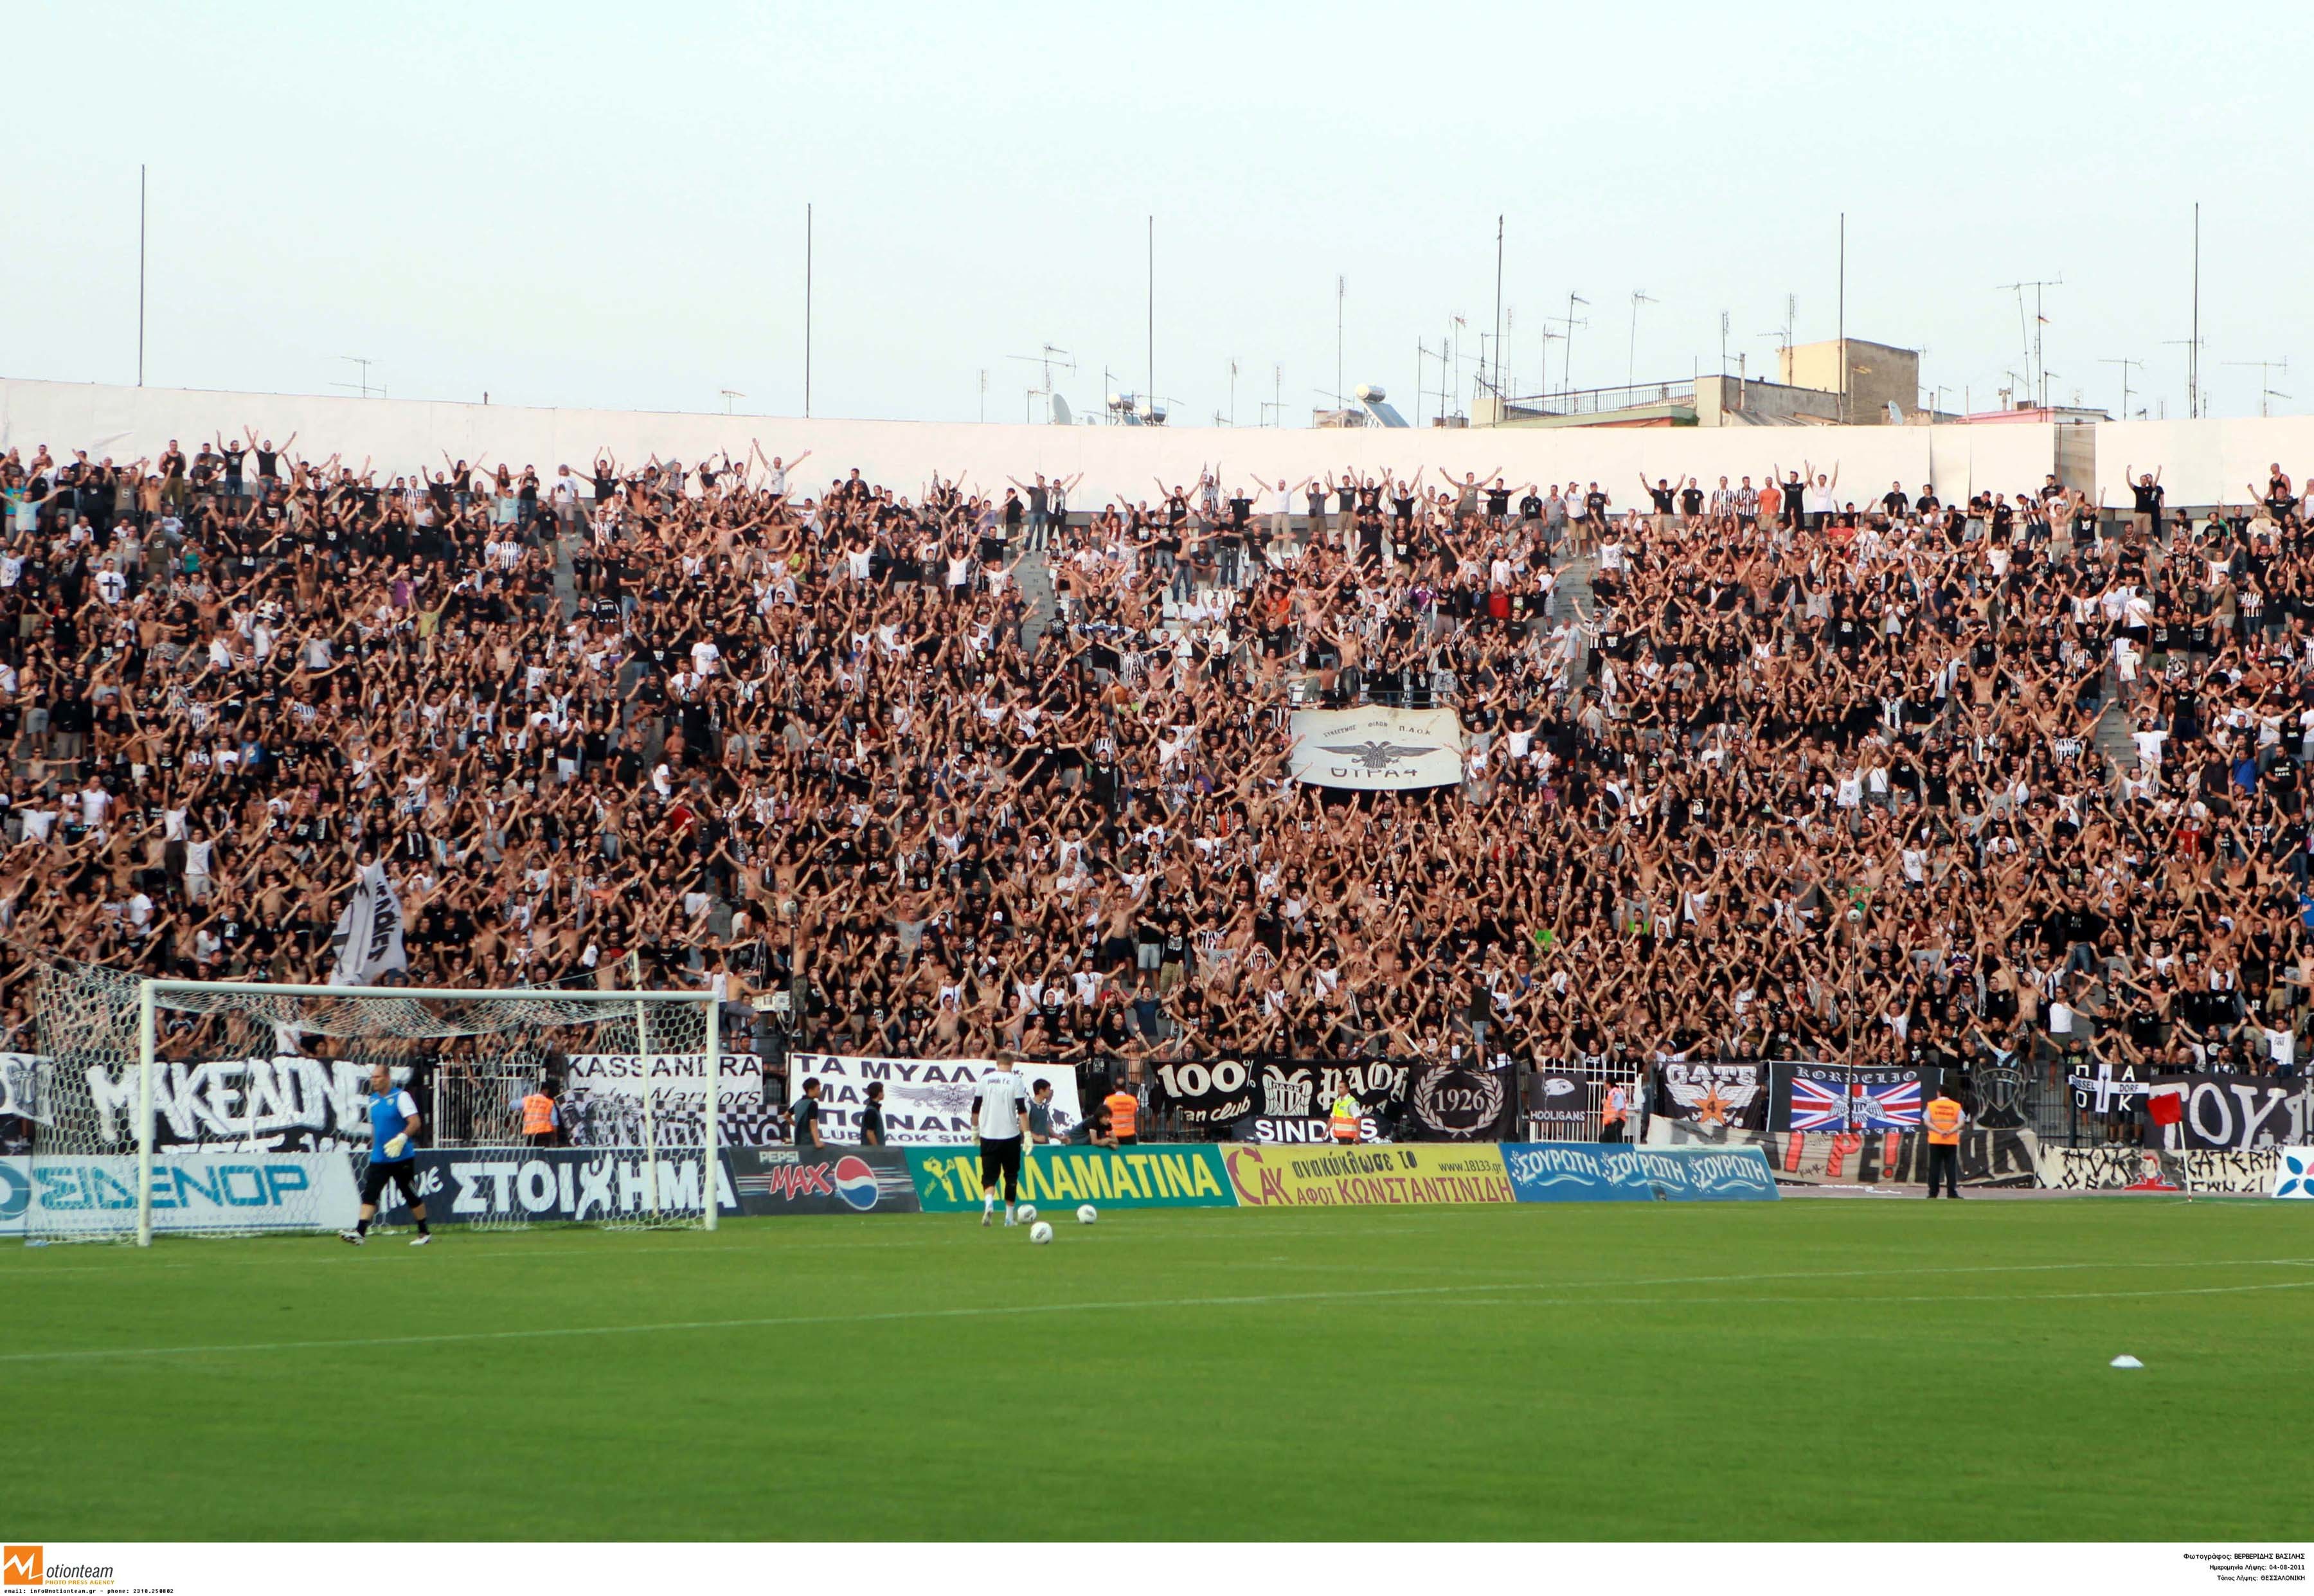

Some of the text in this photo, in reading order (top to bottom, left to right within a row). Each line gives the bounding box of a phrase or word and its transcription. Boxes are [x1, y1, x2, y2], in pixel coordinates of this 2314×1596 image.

[1158, 1060, 1256, 1098] 100%
[1666, 1064, 1757, 1086] GATE
[1210, 1095, 1251, 1121] club
[1435, 1089, 1485, 1111] 1926
[1530, 1110, 1586, 1121] HOOLIGANS
[1255, 1118, 1378, 1143] SINDS
[759, 1151, 799, 1163] PEPSI
[1439, 1160, 1502, 1174] www.18133.gr
[1518, 1149, 1601, 1184] ΣΟΥΡΩΤΗ
[1607, 1152, 1687, 1185] ΣΟΥΡΩΤΗ
[769, 1162, 833, 1201] MAX
[1693, 1155, 1769, 1190] ΣΟΥΡΩΤΗ
[1336, 1177, 1515, 1204] ΚΩΝΣΤΑΝΤΙΝΙΔΗ
